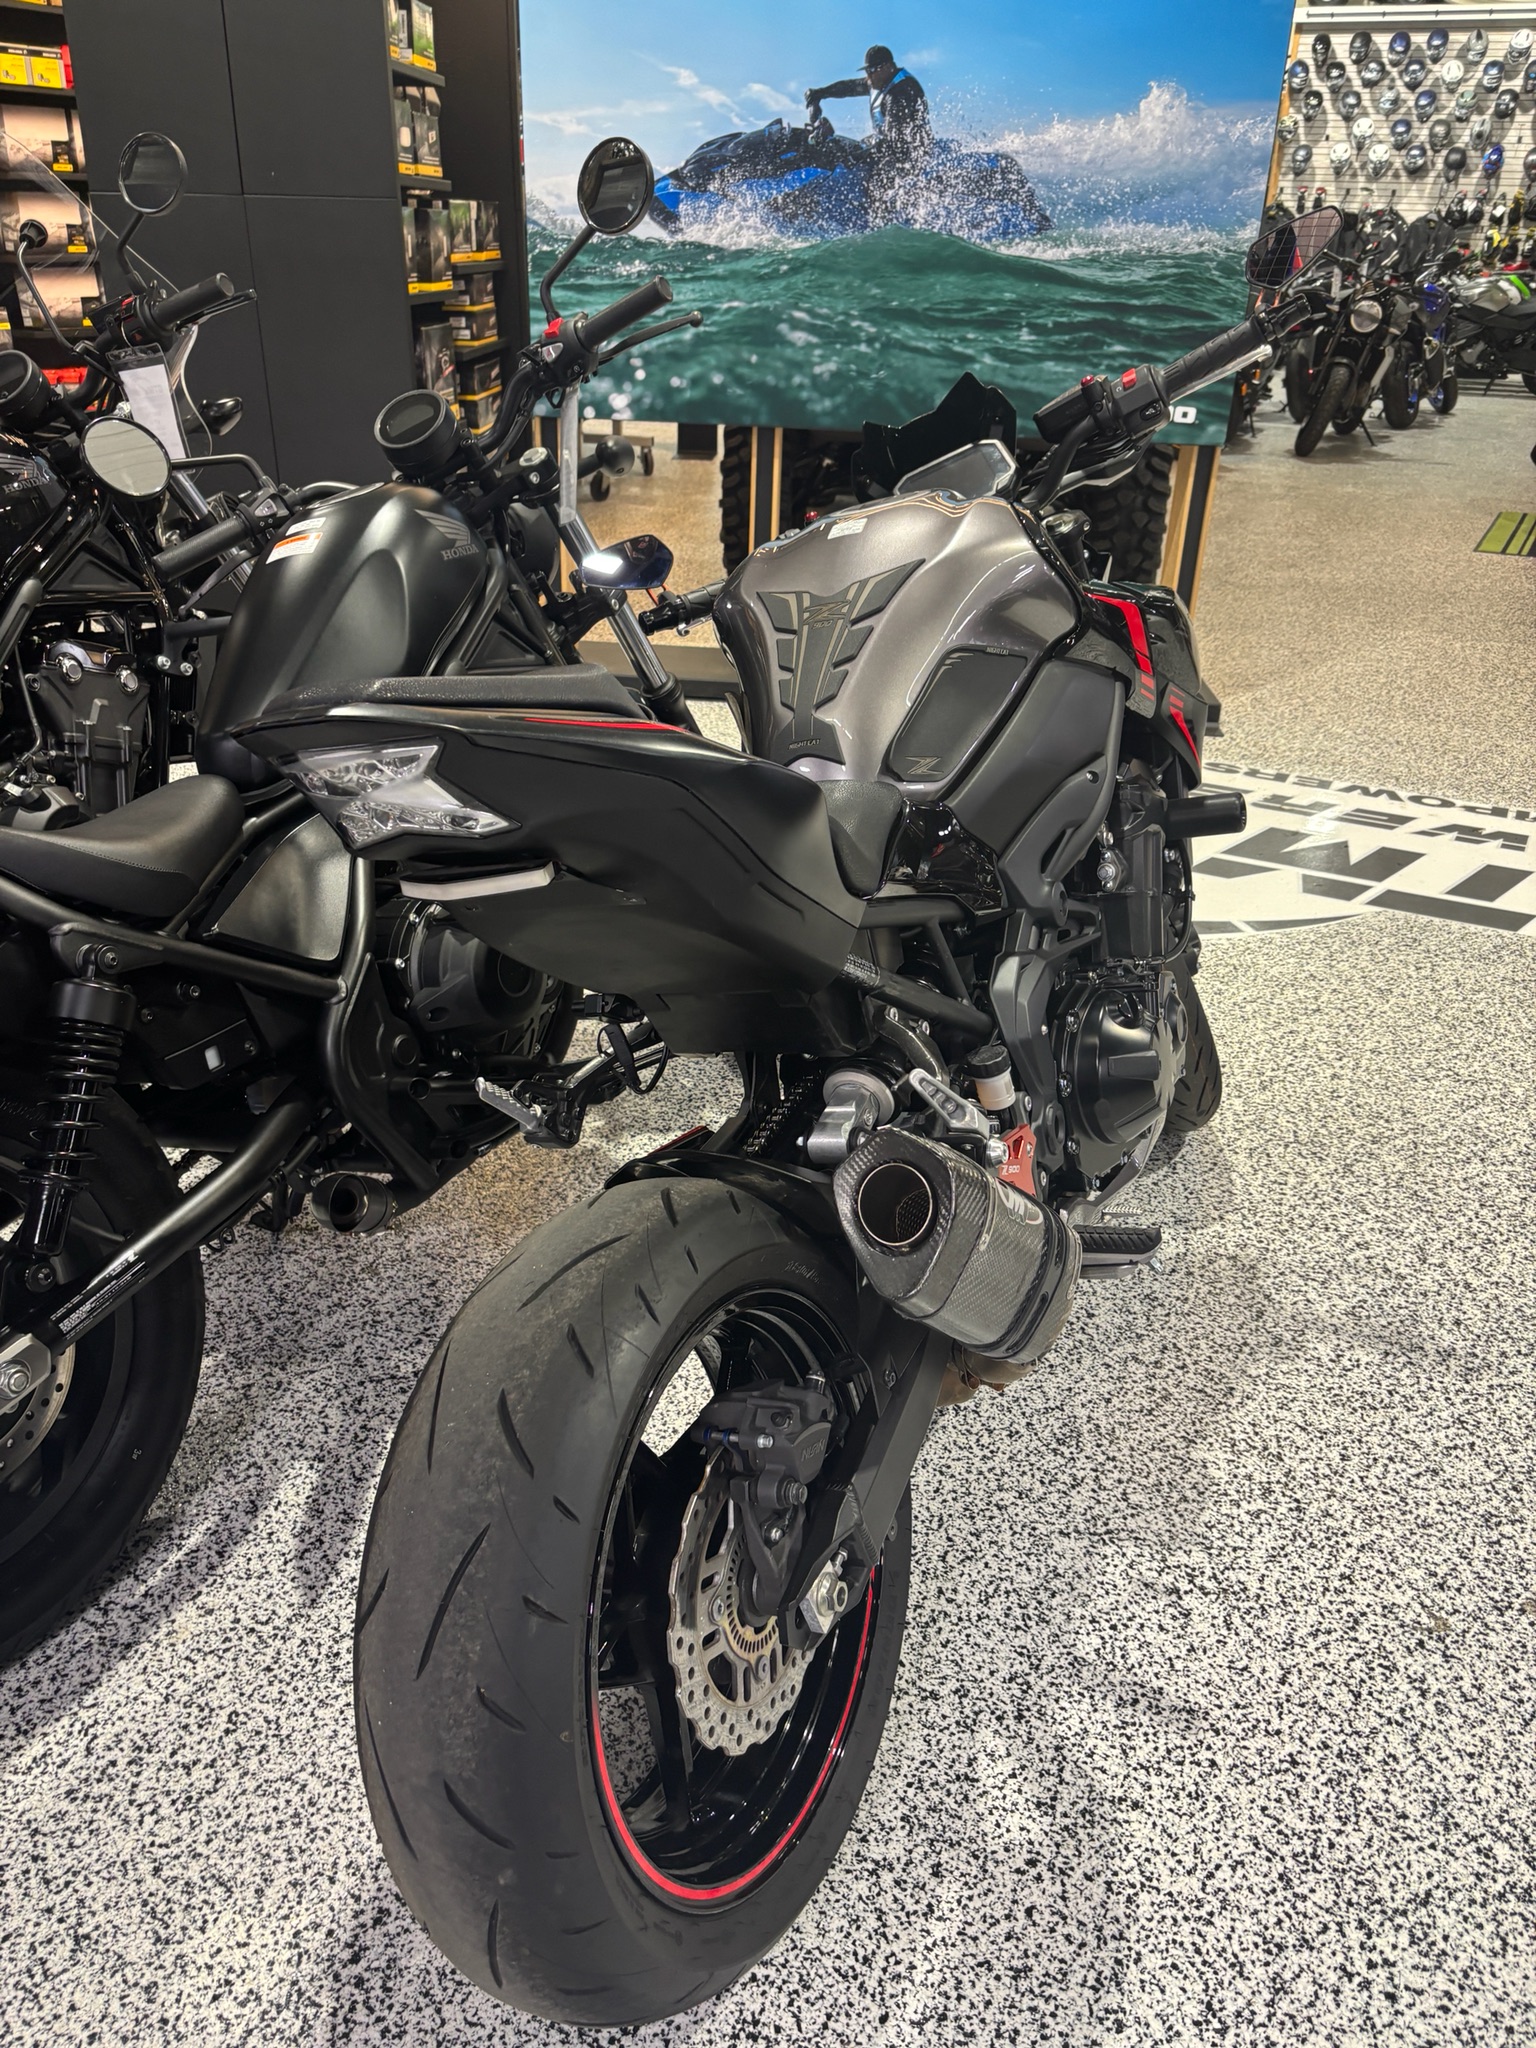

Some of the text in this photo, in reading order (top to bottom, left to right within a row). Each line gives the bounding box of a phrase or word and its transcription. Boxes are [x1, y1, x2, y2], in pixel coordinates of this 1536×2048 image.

[2, 476, 49, 495] HONDA
[440, 543, 480, 561] HONDA
[811, 619, 833, 630] 900
